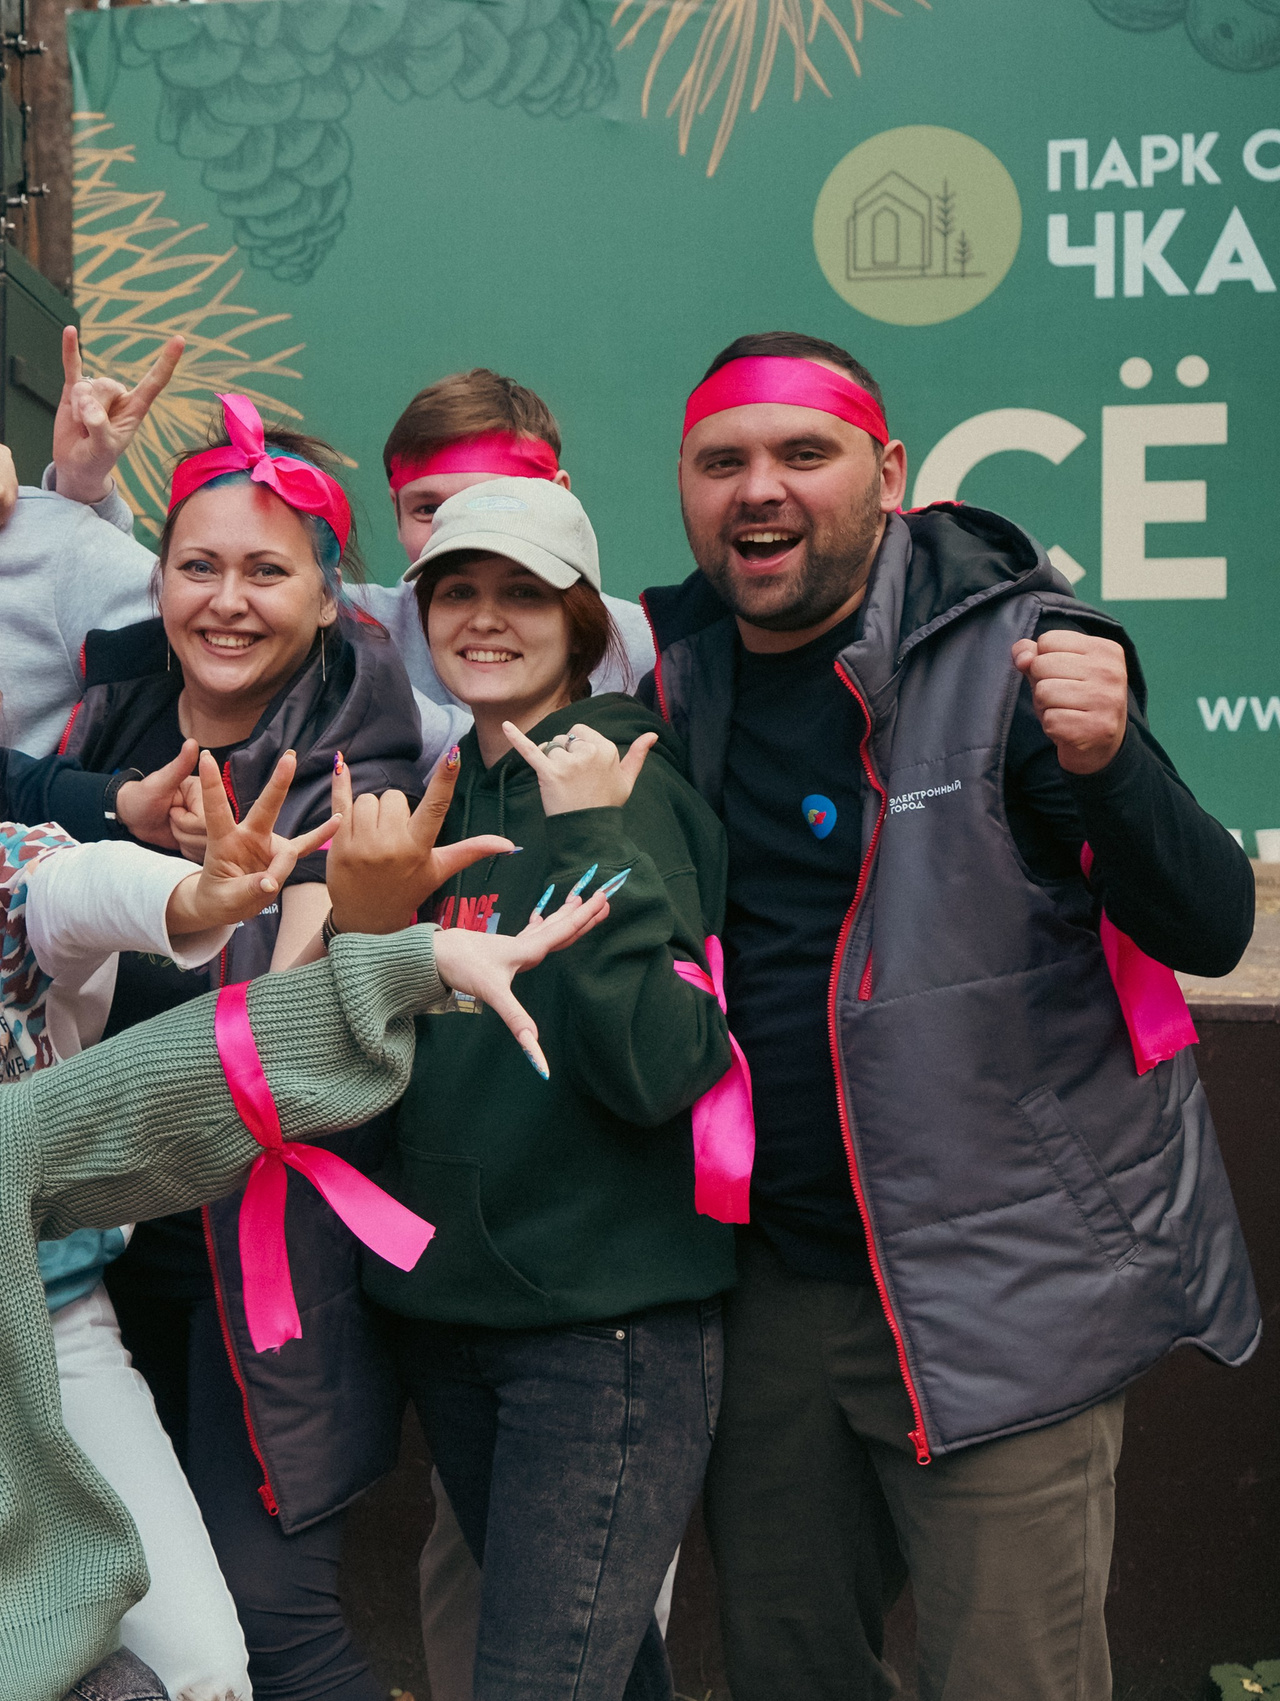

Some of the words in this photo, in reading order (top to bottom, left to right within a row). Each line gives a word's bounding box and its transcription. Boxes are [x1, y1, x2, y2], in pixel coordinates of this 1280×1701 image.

[1047, 131, 1222, 192] ПАРК
[1047, 204, 1277, 299] ЧКА
[888, 779, 962, 807] ЭЛЕКТРОННЫЙ
[890, 800, 926, 815] ГОРОД
